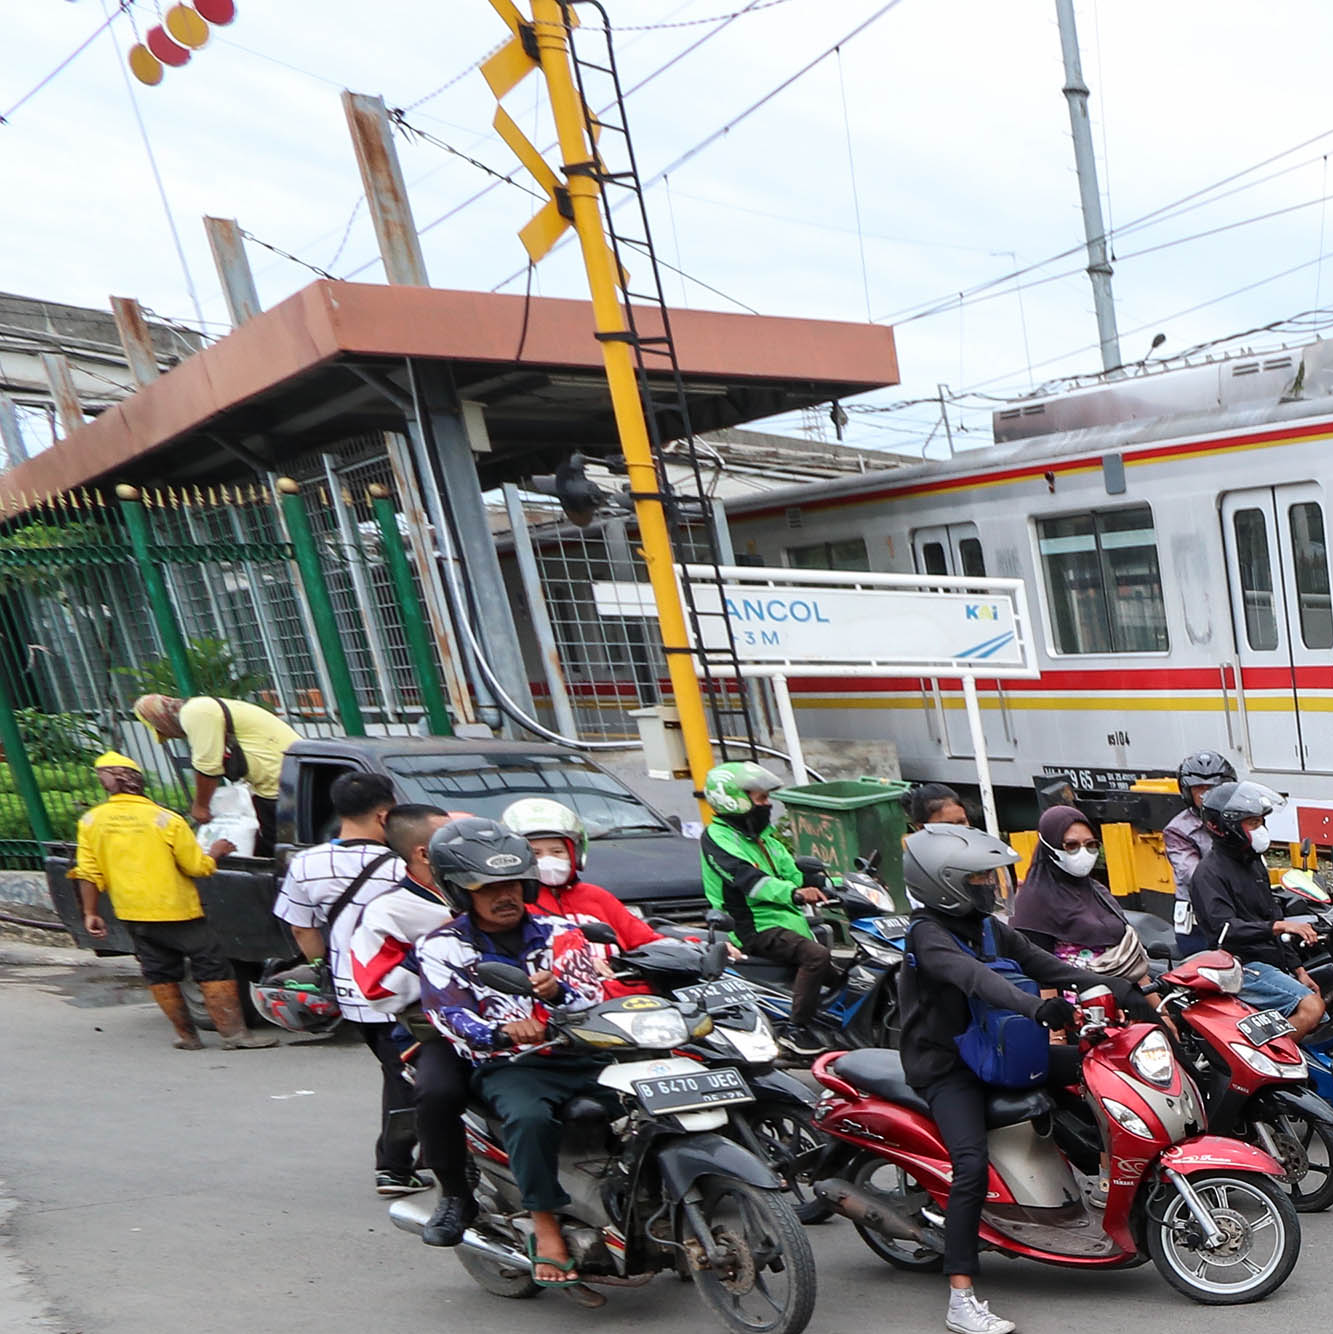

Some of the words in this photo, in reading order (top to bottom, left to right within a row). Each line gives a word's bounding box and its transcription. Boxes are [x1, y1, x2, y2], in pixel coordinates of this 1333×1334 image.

[640, 1083, 655, 1098] B
[657, 1078, 699, 1095] 6470
[706, 1073, 739, 1089] UEC
